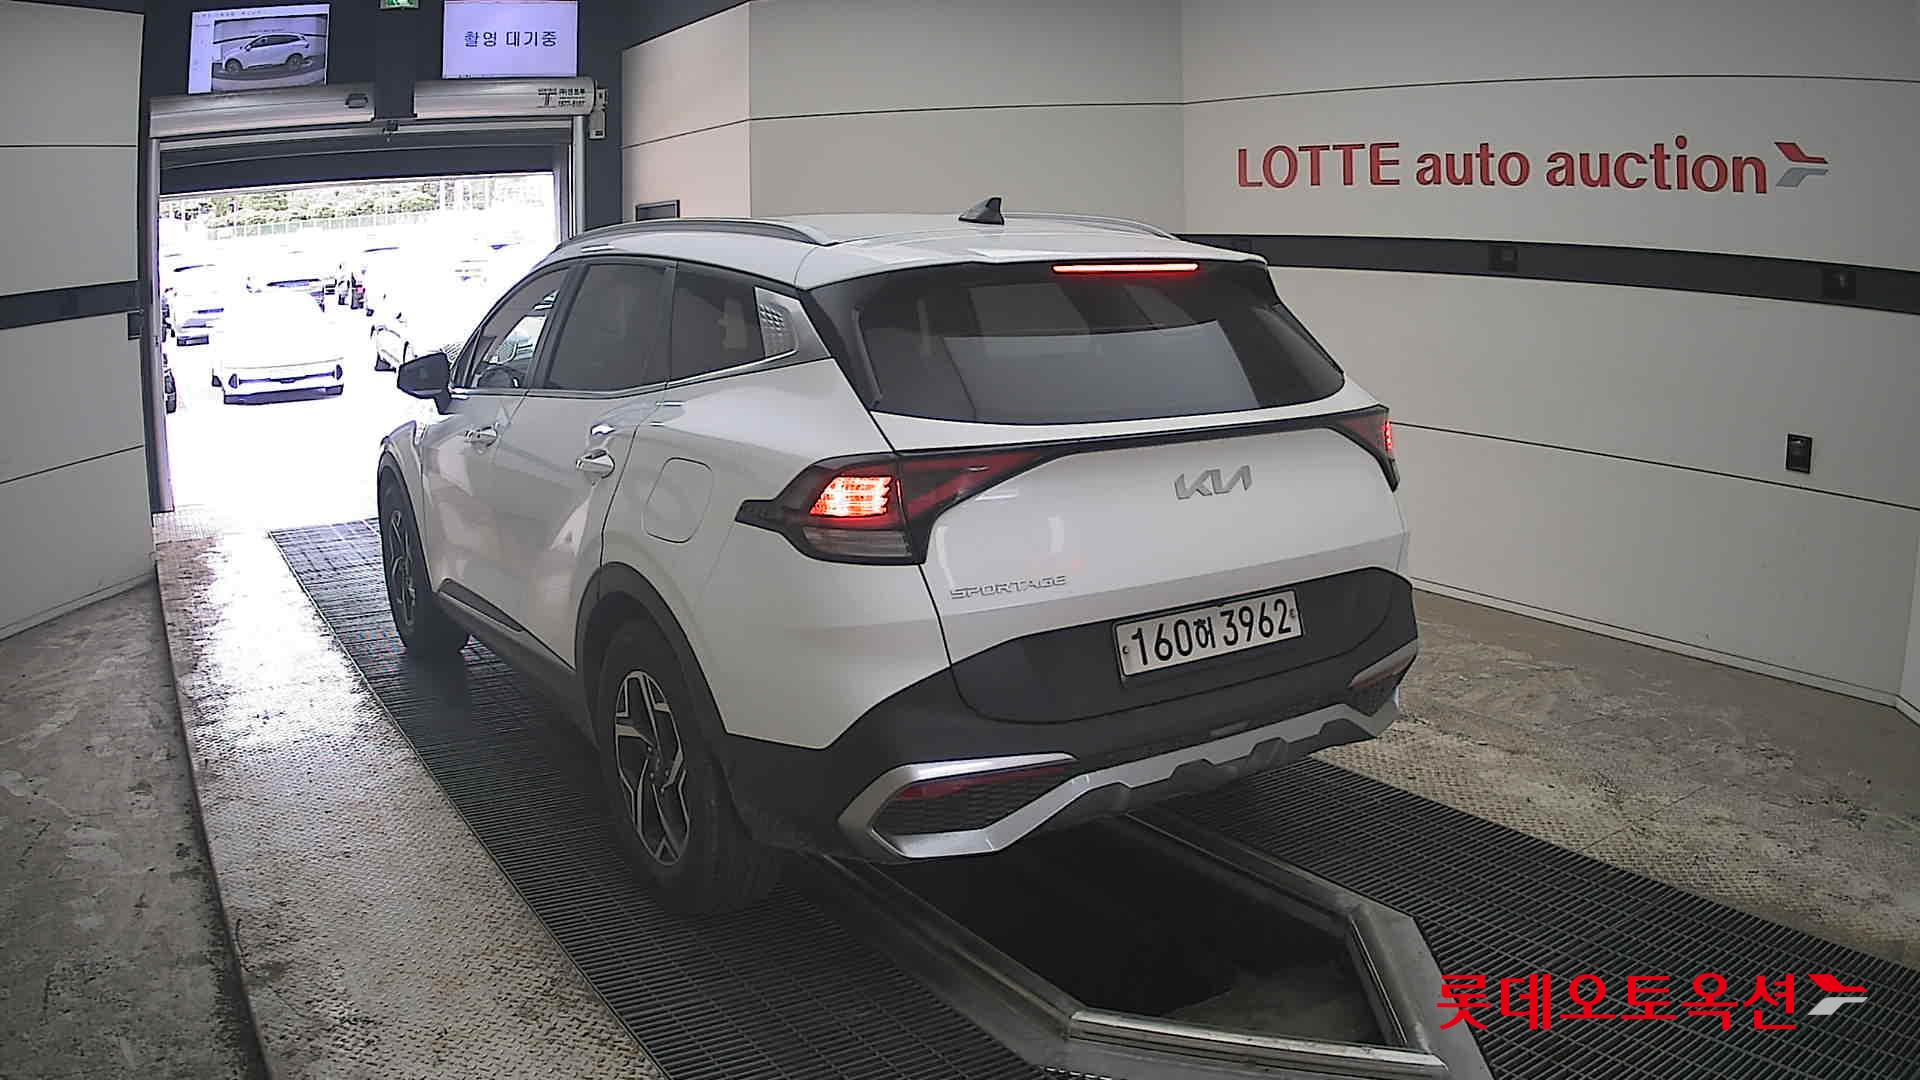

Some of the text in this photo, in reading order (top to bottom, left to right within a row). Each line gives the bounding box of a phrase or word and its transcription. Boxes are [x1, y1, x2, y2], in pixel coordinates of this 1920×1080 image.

[464, 31, 558, 48] 촬영 대기중
[1237, 135, 1768, 195] LOTTE auto auction
[950, 574, 1068, 600] SPORTAGE
[1131, 597, 1292, 666] 160허 3962
